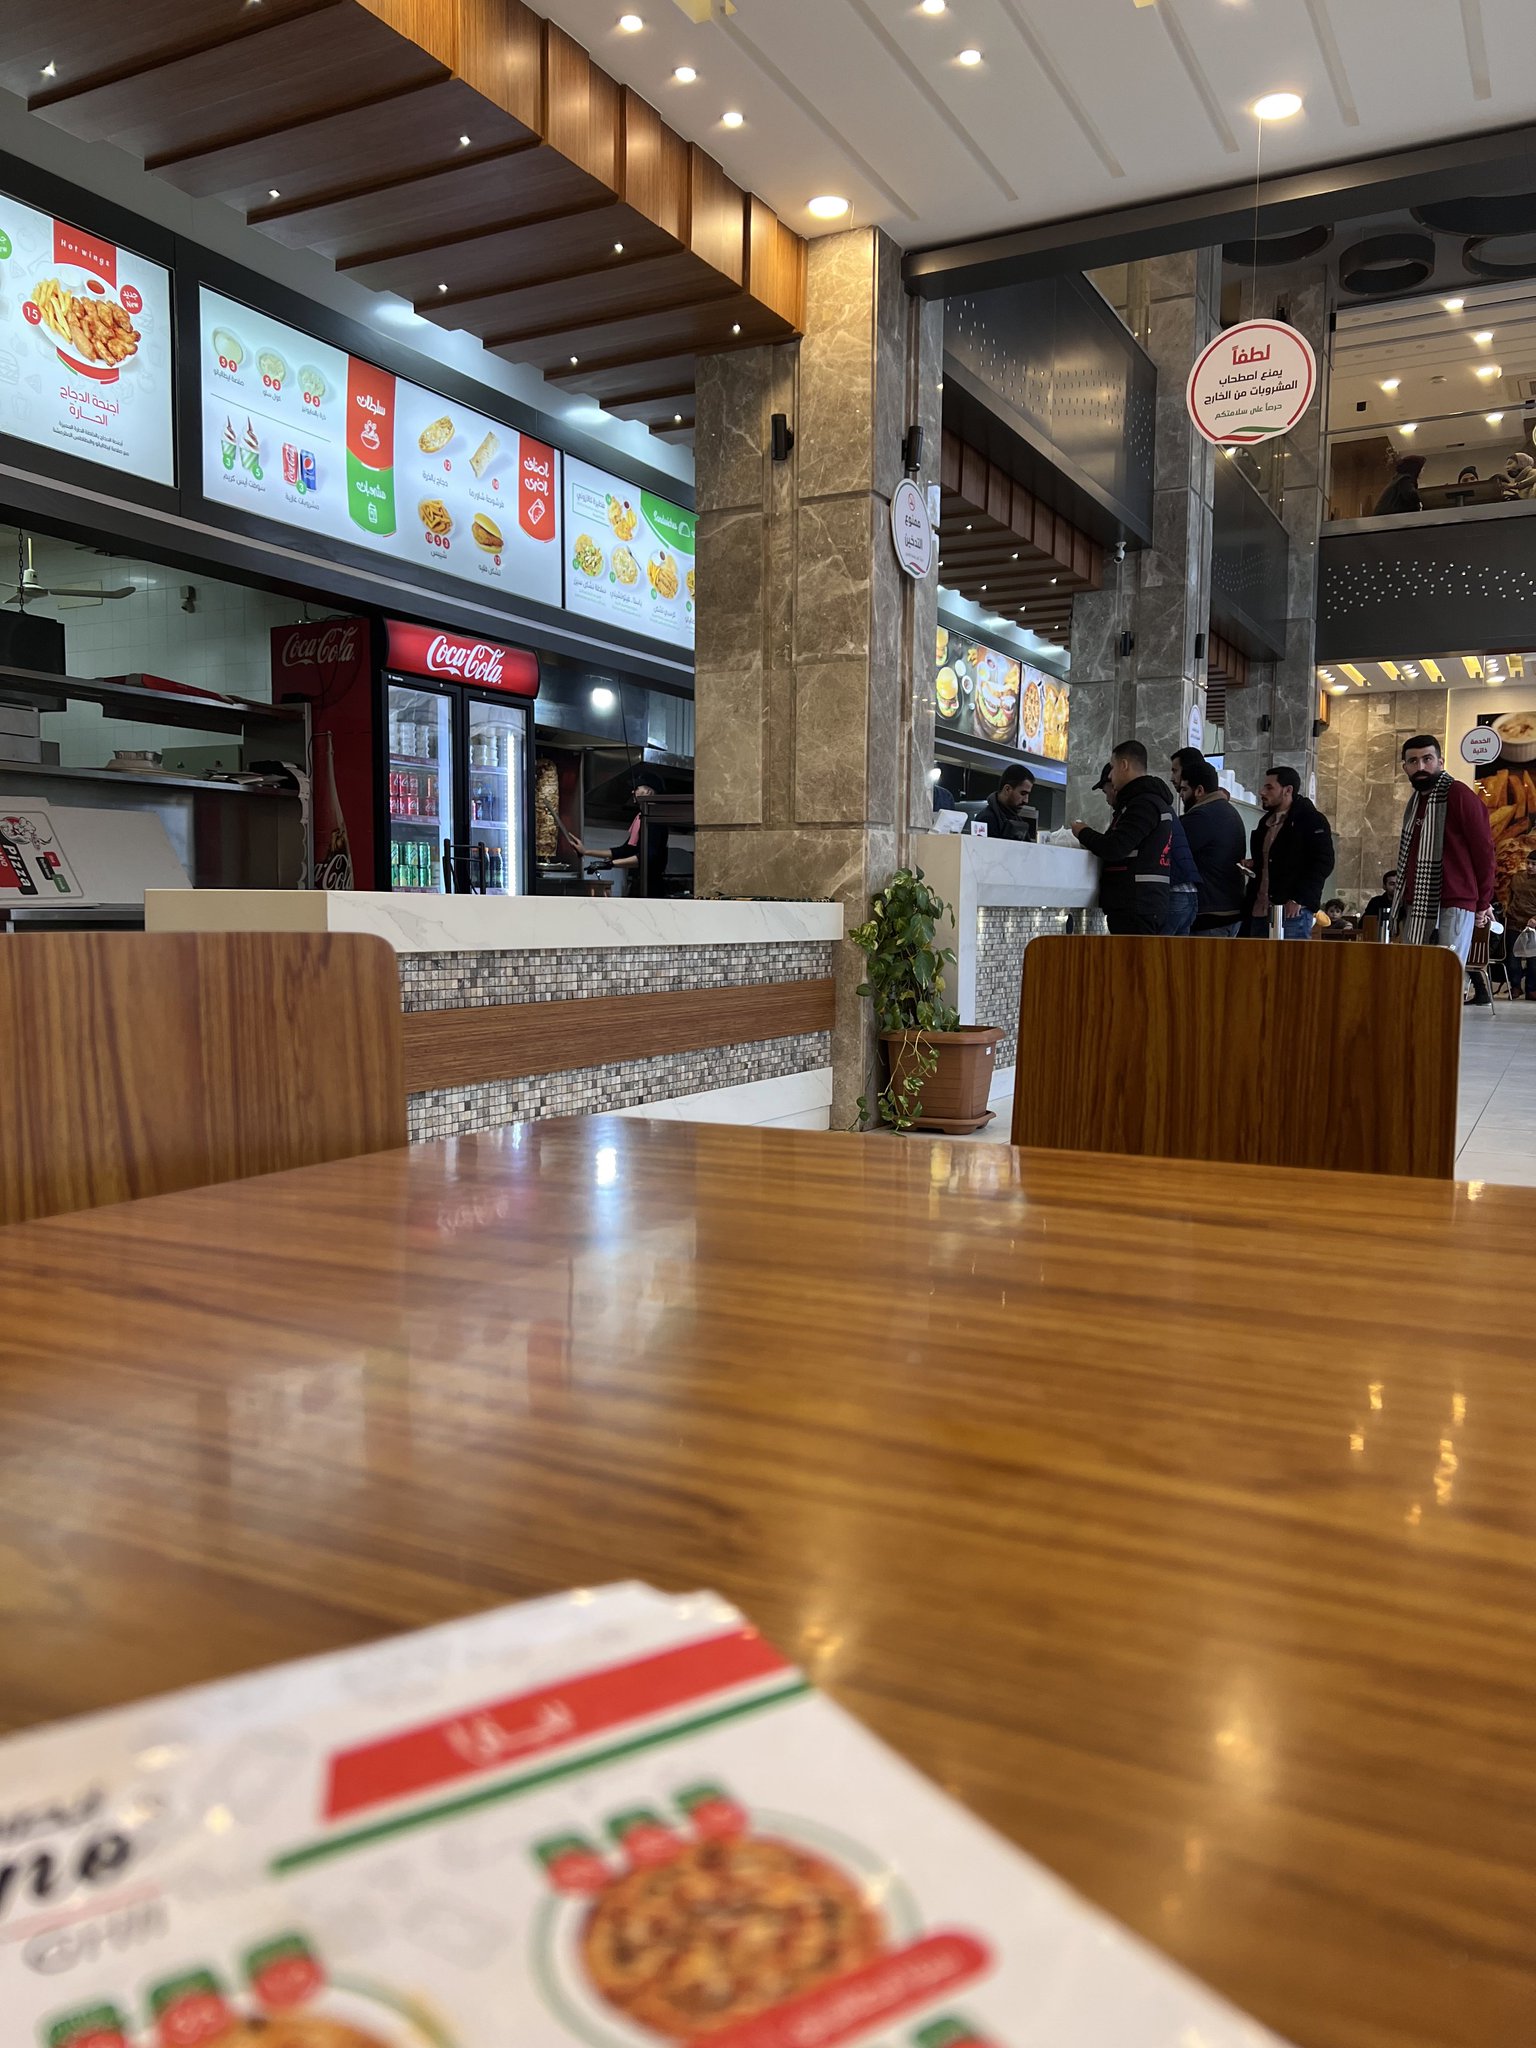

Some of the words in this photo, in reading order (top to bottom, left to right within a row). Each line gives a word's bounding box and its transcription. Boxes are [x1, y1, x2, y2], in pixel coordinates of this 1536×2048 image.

[60, 238, 78, 252] Hot
[82, 249, 110, 266] wings
[122, 290, 139, 300] جديد
[126, 300, 139, 308] New
[26, 307, 38, 320] 15
[1219, 371, 1258, 388] اصطحاب
[1260, 369, 1283, 382] يمنع
[60, 386, 90, 404] الدجاج
[1234, 390, 1247, 400] من
[1250, 380, 1298, 397] المشروبات
[92, 394, 120, 416] أجنحة
[357, 395, 386, 416] سلطات
[1214, 408, 1248, 420] سلامتكم
[356, 480, 386, 500] مشروبات
[905, 515, 921, 528] ممنوع
[905, 533, 923, 549] التدخين
[282, 627, 358, 667] Coca-Cola
[427, 636, 505, 684] Coca-Cola
[2, 844, 31, 886] Pizza
